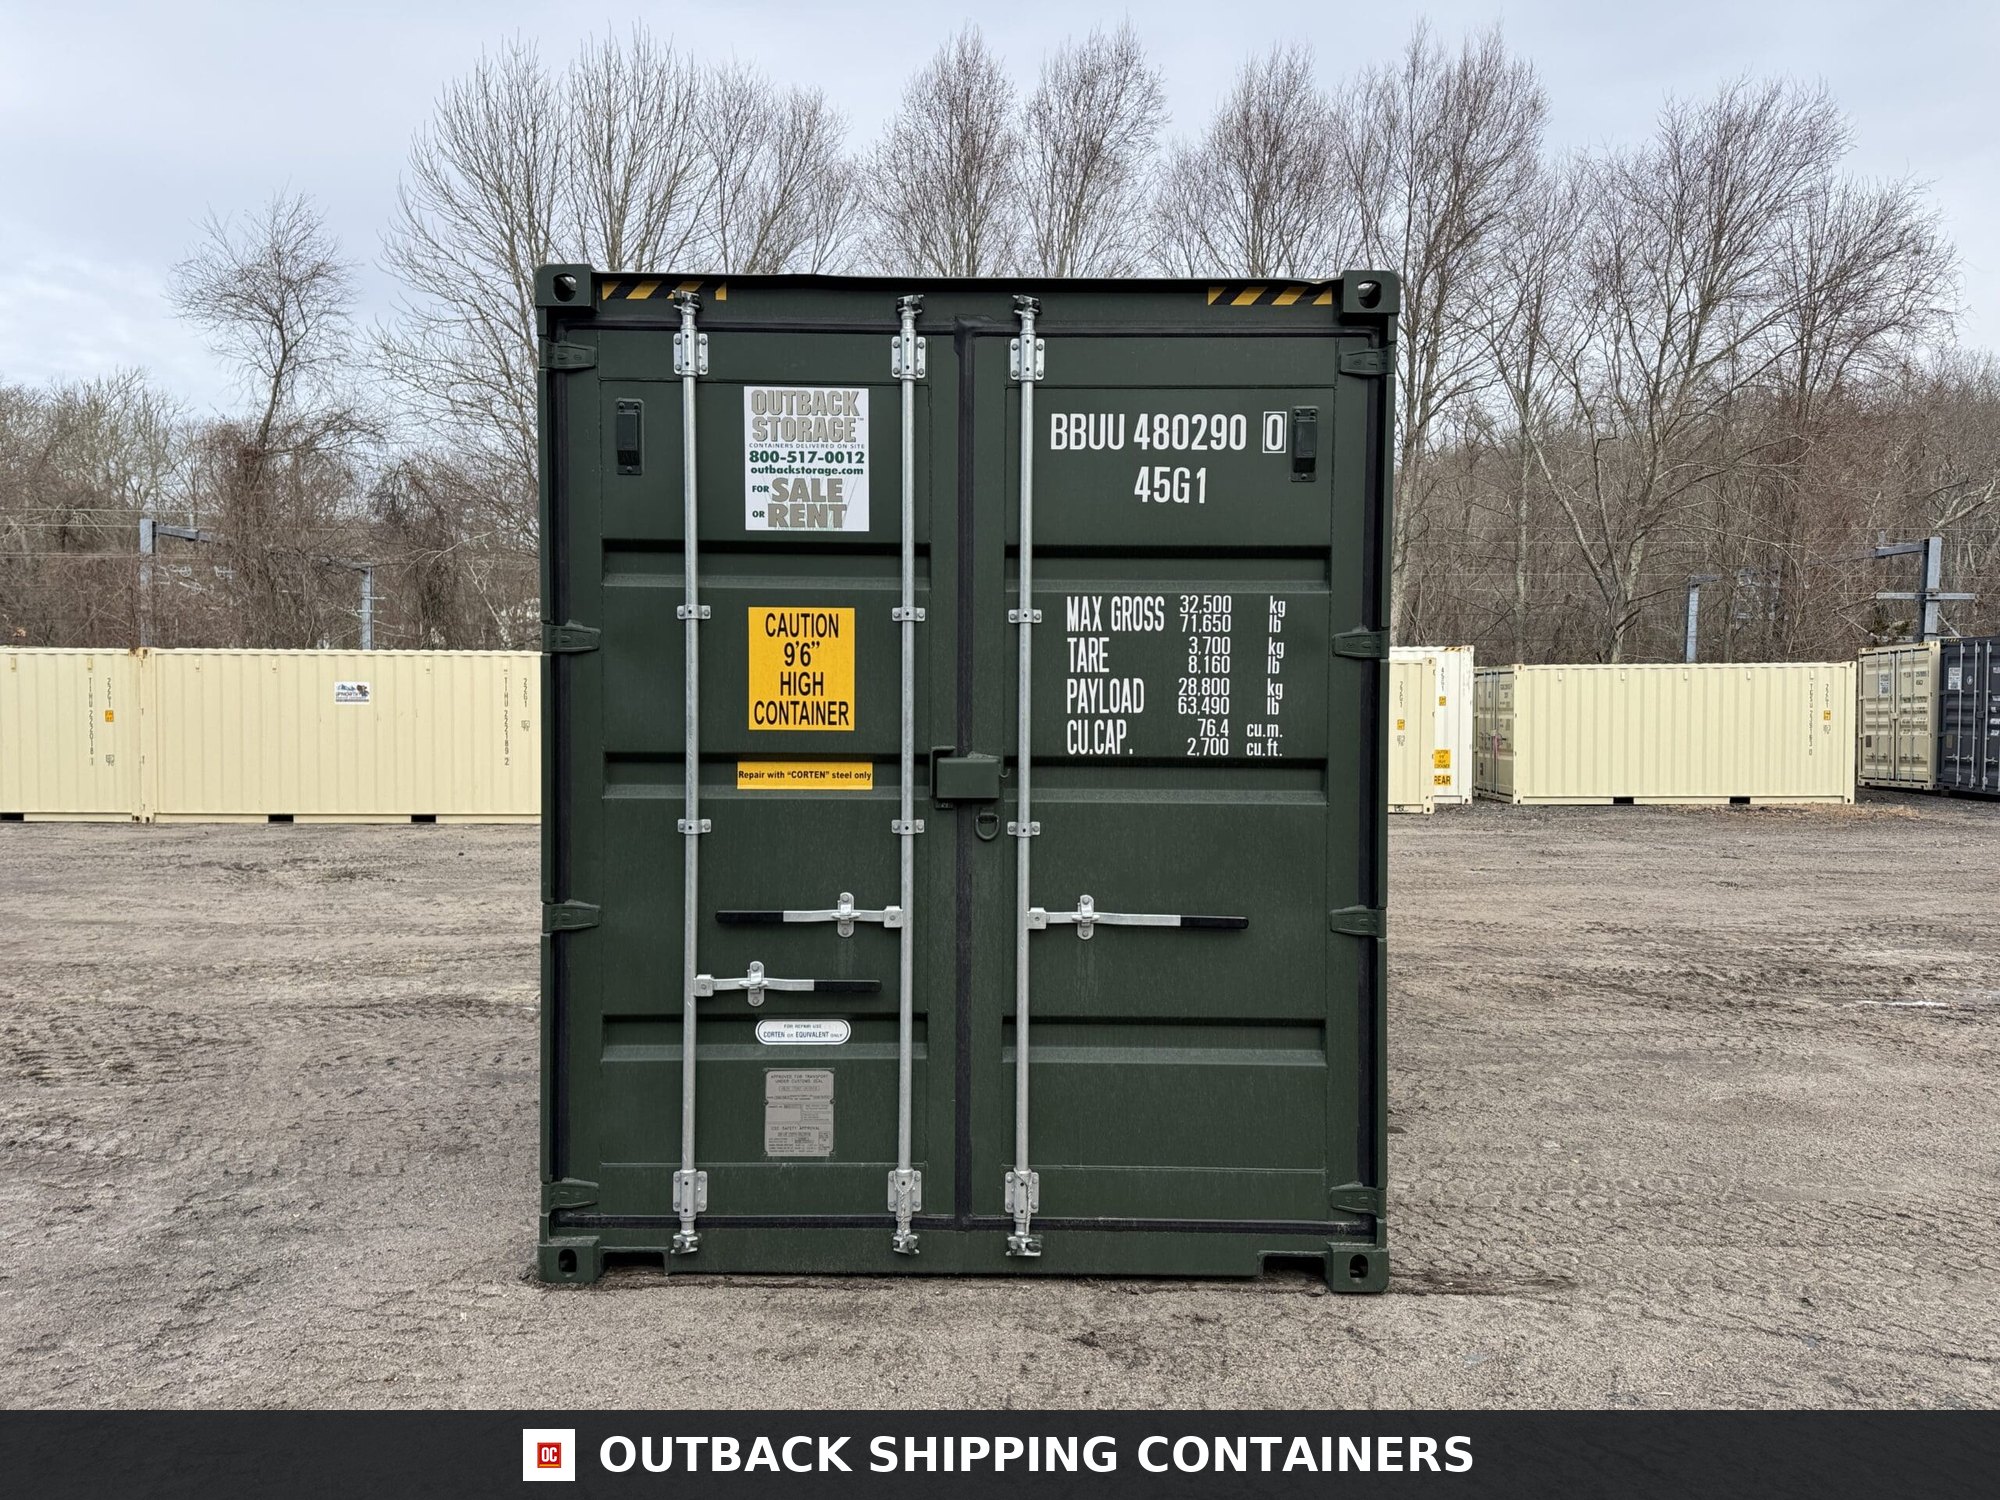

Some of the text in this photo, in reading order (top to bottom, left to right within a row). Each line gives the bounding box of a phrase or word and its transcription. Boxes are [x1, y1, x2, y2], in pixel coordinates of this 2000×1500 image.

[751, 390, 860, 416] OUTBACK
[752, 417, 856, 443] STORAGE
[1051, 413, 1283, 451] BBUU 480290 0
[749, 450, 865, 464] 800-517-0012
[751, 464, 864, 476] outbackstorage.com
[752, 477, 843, 503] FOR SALE
[1134, 466, 1206, 504] 45G1
[768, 503, 847, 528] RENT
[765, 612, 839, 638] CAUTION
[1066, 595, 1286, 632] MAX GROSS 32,500 kg
[1179, 614, 1281, 633] 71,650 lb
[1067, 636, 1285, 673] TARE 3,700 kg
[1188, 655, 1280, 674] 8,160 lb
[780, 671, 824, 696] HIGH
[1067, 677, 1283, 714] PAYLOAD 28,800 kg
[754, 700, 849, 726] CONTAINER
[1178, 696, 1279, 715] 63,490 lb
[1067, 718, 1283, 755] CU.CAP. 76.4 cu.m.
[1187, 737, 1283, 756] 2,700 cu.ft.
[738, 771, 765, 780] Repair
[767, 771, 785, 779] with
[832, 771, 852, 779] steel
[854, 771, 871, 780] only
